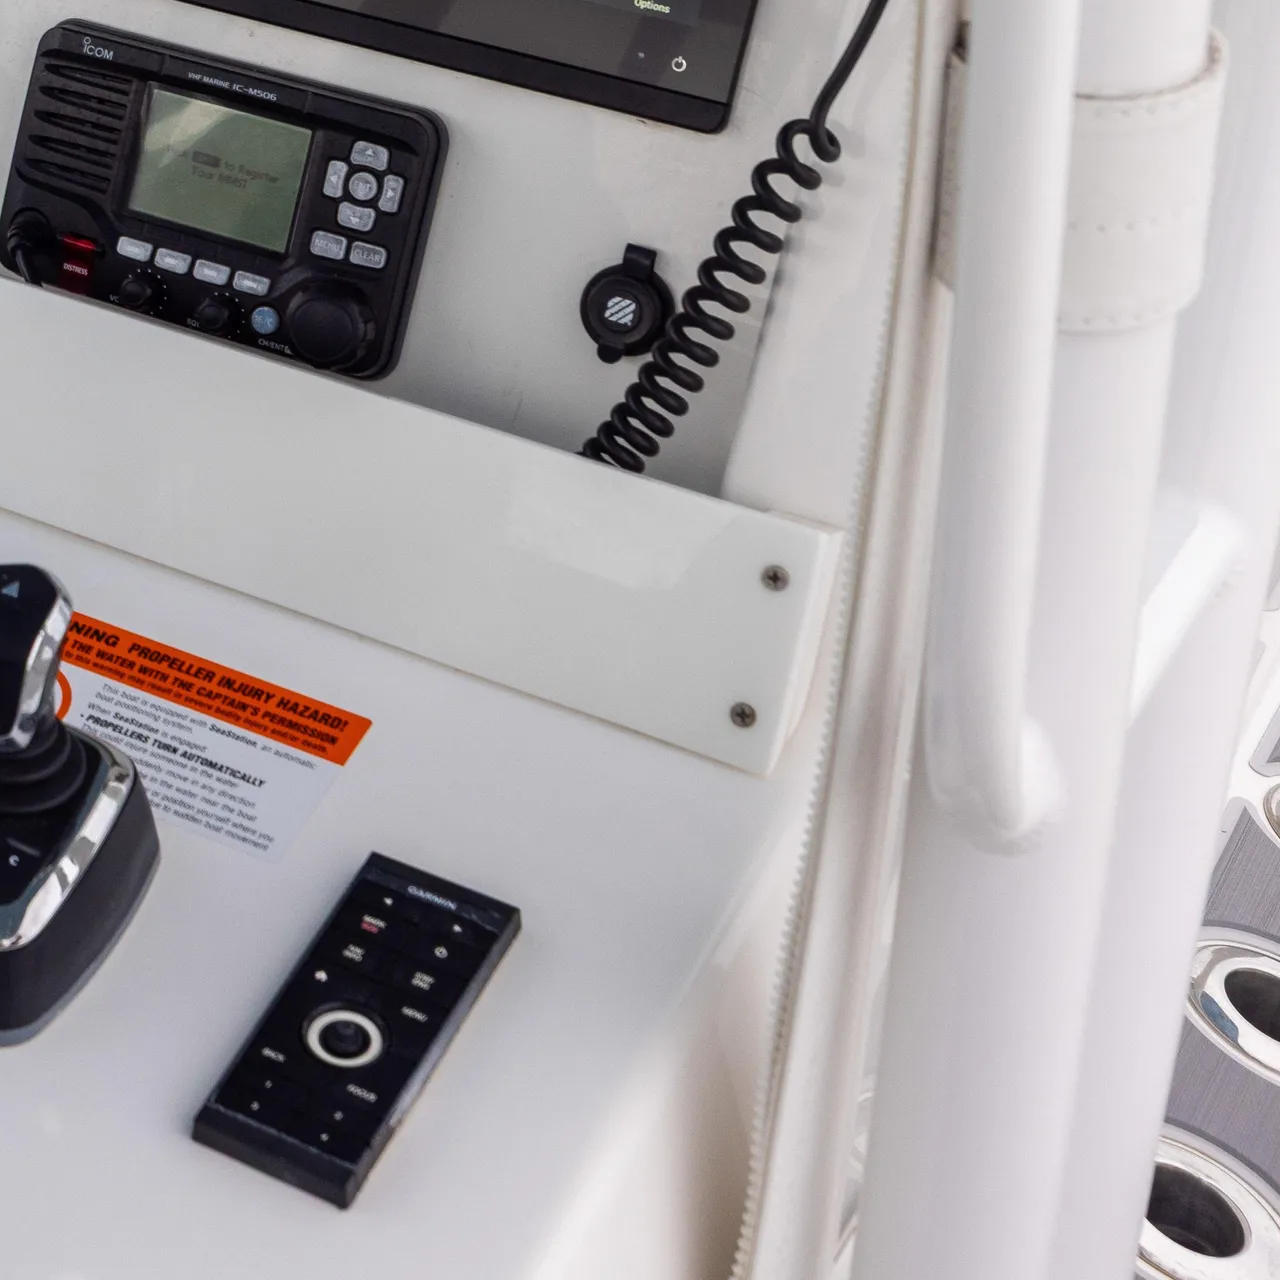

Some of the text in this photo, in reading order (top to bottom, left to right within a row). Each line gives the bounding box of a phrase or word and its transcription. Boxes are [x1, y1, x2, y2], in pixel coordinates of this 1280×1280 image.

[188, 71, 278, 102] VHF MARINE IC-M506
[62, 260, 90, 277] DISTRESS
[353, 248, 382, 261] CLEAR
[68, 620, 349, 732] NING PROPELLER INJURY HAZARD!
[70, 639, 340, 745] THE WATER WITH THE CAPTAIN'S PERMISSION
[84, 713, 267, 788] PROPELLERS TURN AUTOMATICALLY
[8, 854, 20, 867] C
